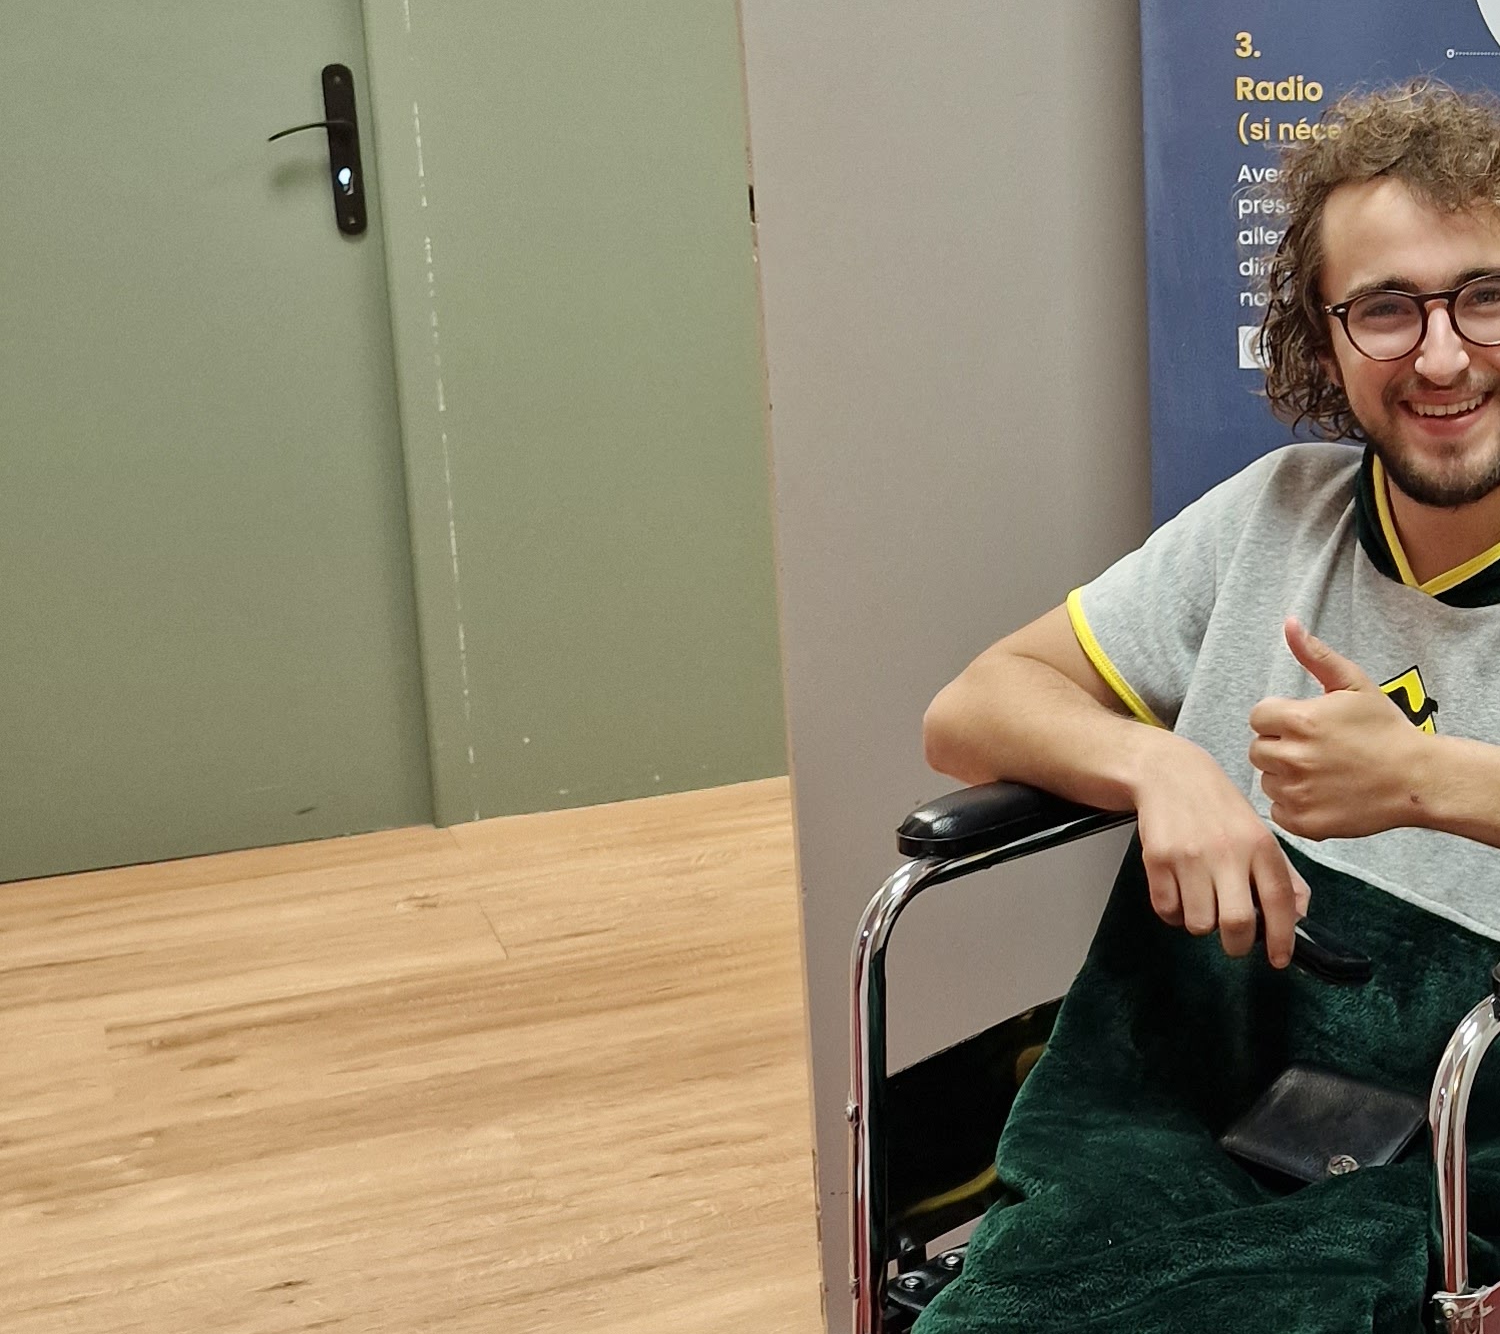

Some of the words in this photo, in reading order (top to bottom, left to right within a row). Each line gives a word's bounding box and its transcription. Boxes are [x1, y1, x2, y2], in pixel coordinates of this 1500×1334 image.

[1234, 32, 1261, 58] 3.
[1235, 75, 1323, 102] Radio
[1238, 112, 1270, 145] (si
